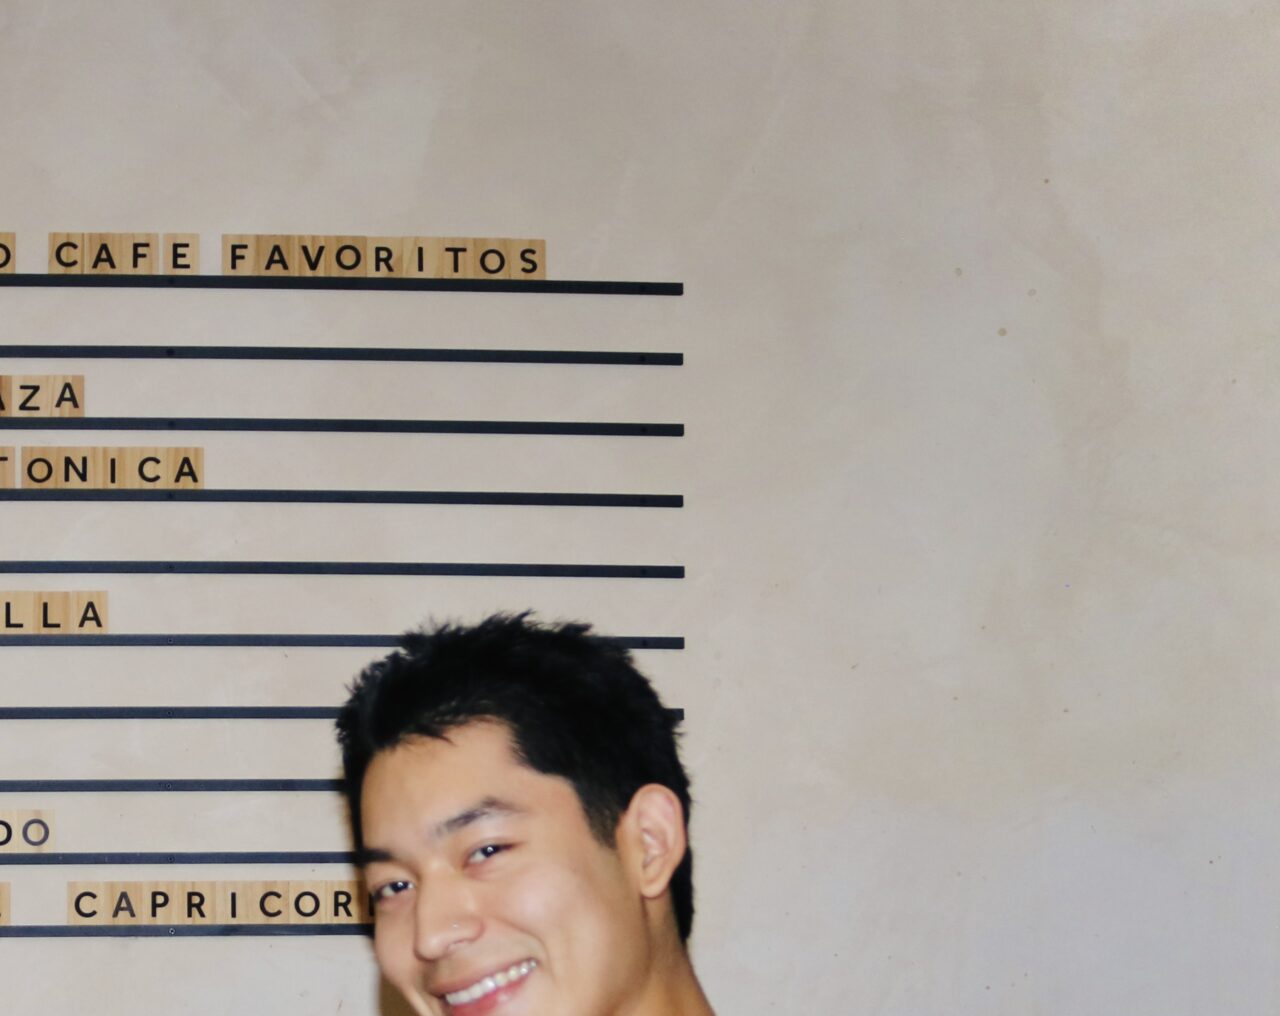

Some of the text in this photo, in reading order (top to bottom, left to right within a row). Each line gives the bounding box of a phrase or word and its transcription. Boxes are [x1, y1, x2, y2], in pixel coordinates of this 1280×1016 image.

[54, 240, 191, 270] CAFE
[230, 243, 538, 275] FAVORITOS
[74, 890, 374, 920] CAPRICOR
